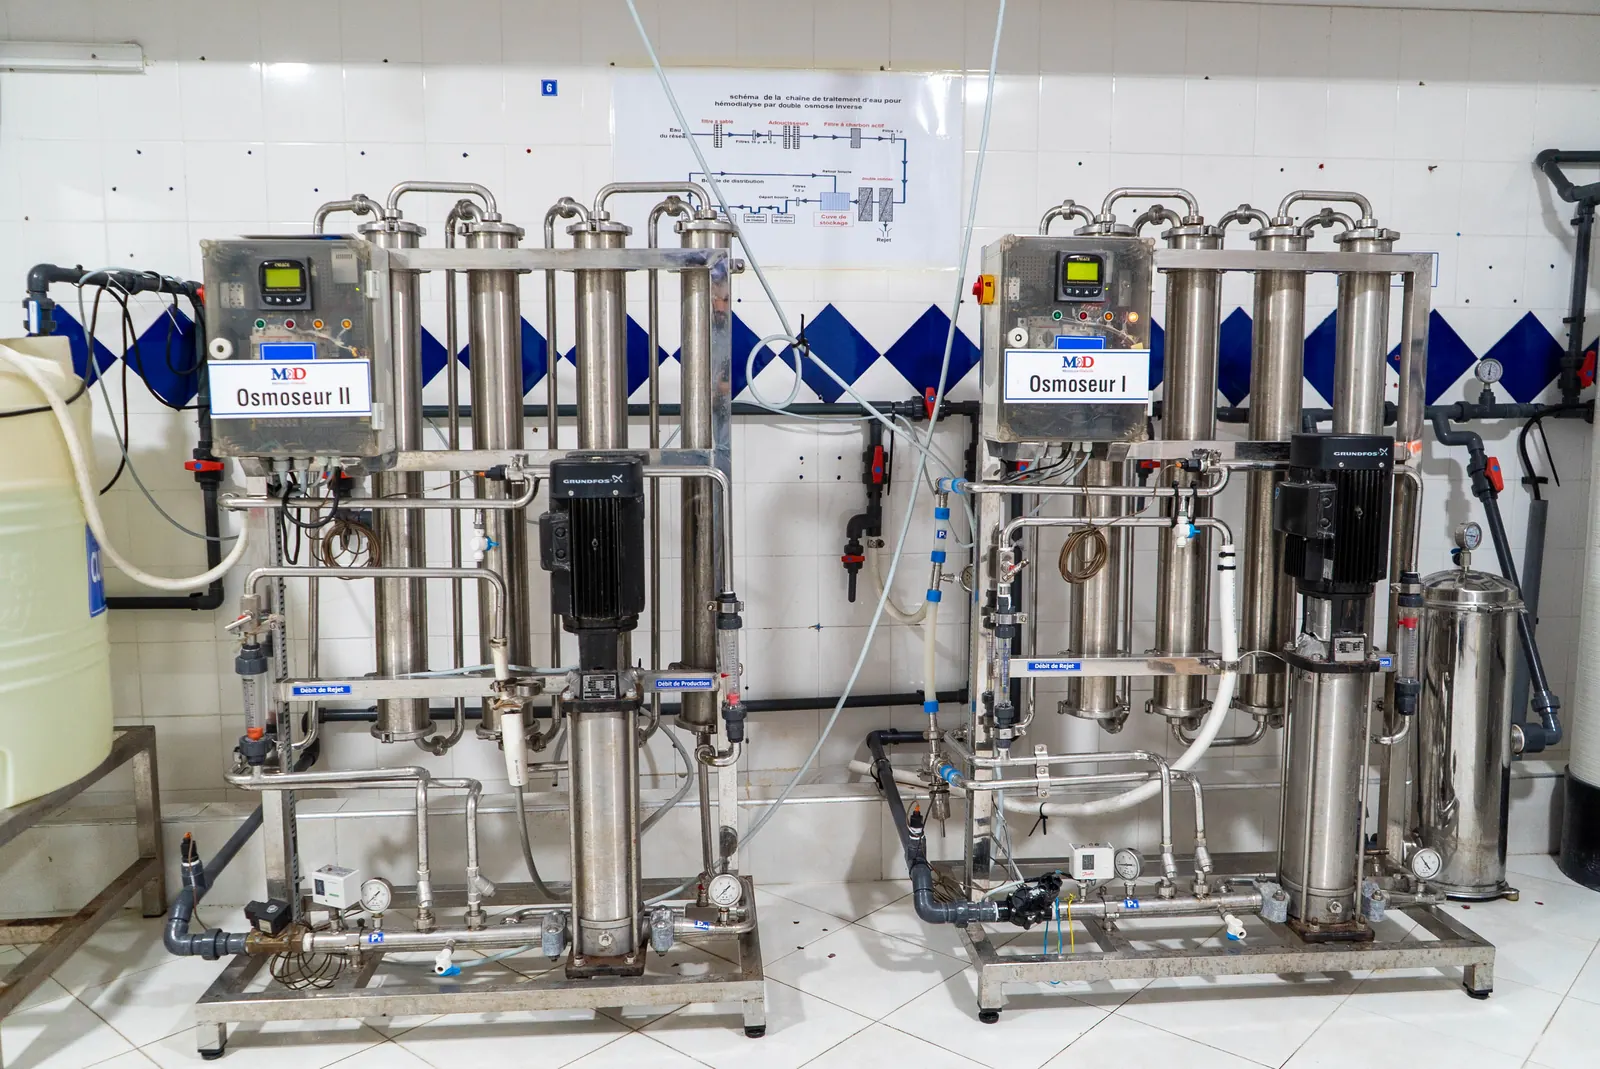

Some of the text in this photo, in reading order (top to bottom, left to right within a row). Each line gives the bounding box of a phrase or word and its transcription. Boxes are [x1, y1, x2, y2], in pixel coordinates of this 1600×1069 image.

[546, 83, 553, 93] 6
[729, 93, 759, 101] schéma
[1029, 375, 1126, 393] Osmoseur I
[236, 387, 351, 407] Osmoseur II
[327, 686, 344, 694] Rejet
